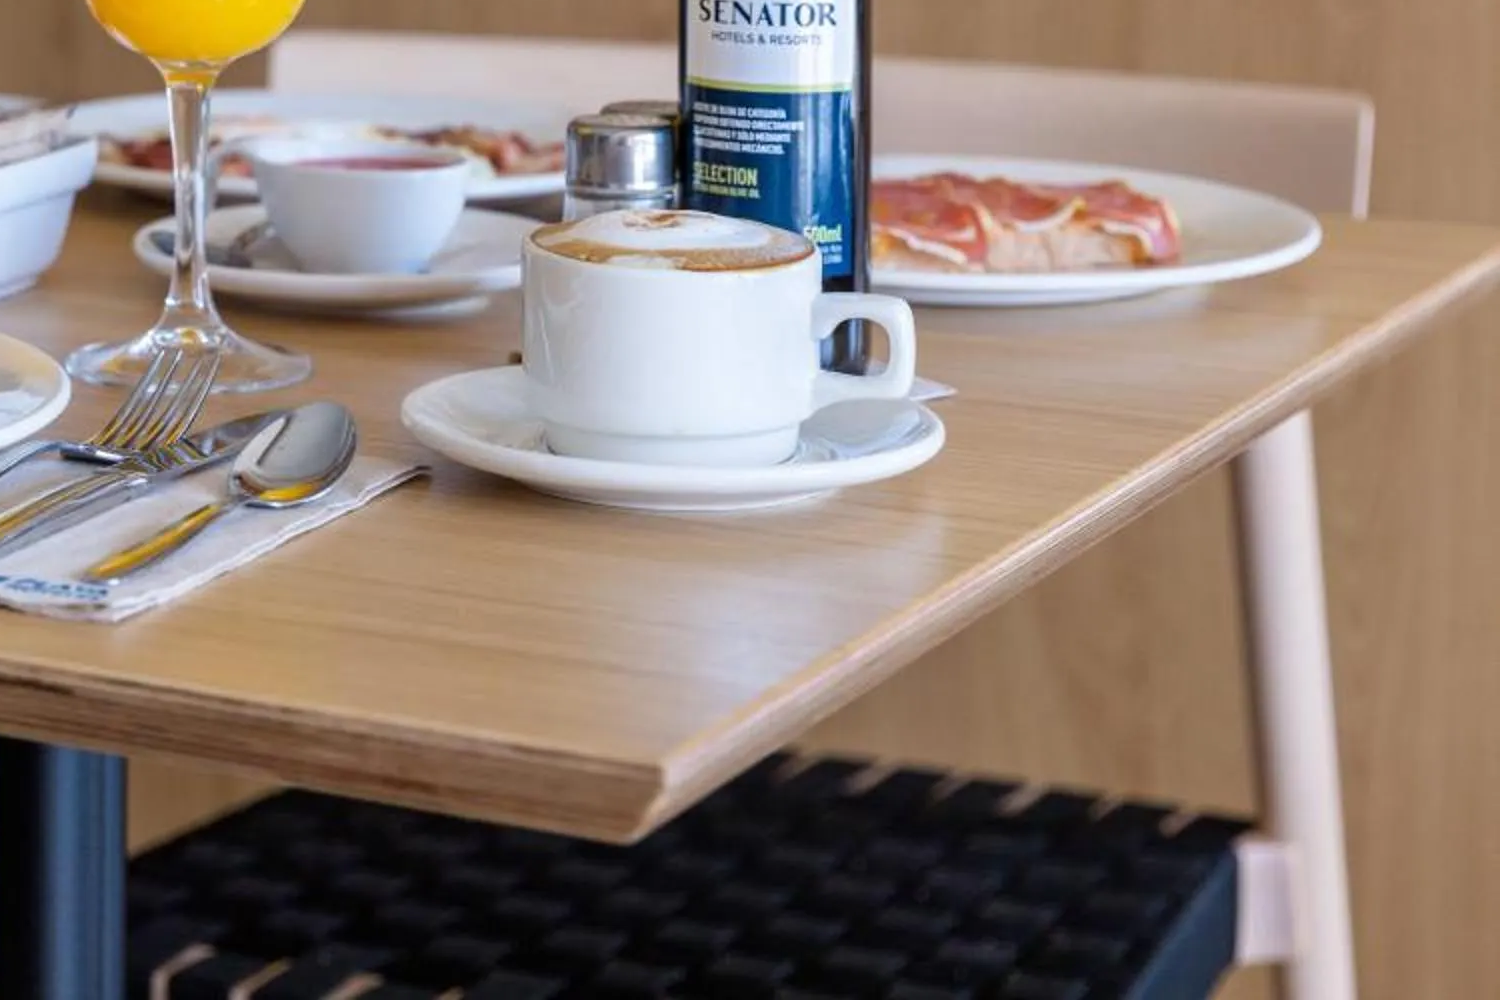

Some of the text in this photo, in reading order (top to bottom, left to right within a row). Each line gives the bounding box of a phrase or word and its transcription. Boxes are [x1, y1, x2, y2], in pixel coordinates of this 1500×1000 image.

[711, 31, 821, 46] HOTELS & RESORTS
[693, 161, 758, 186] SELECTION
